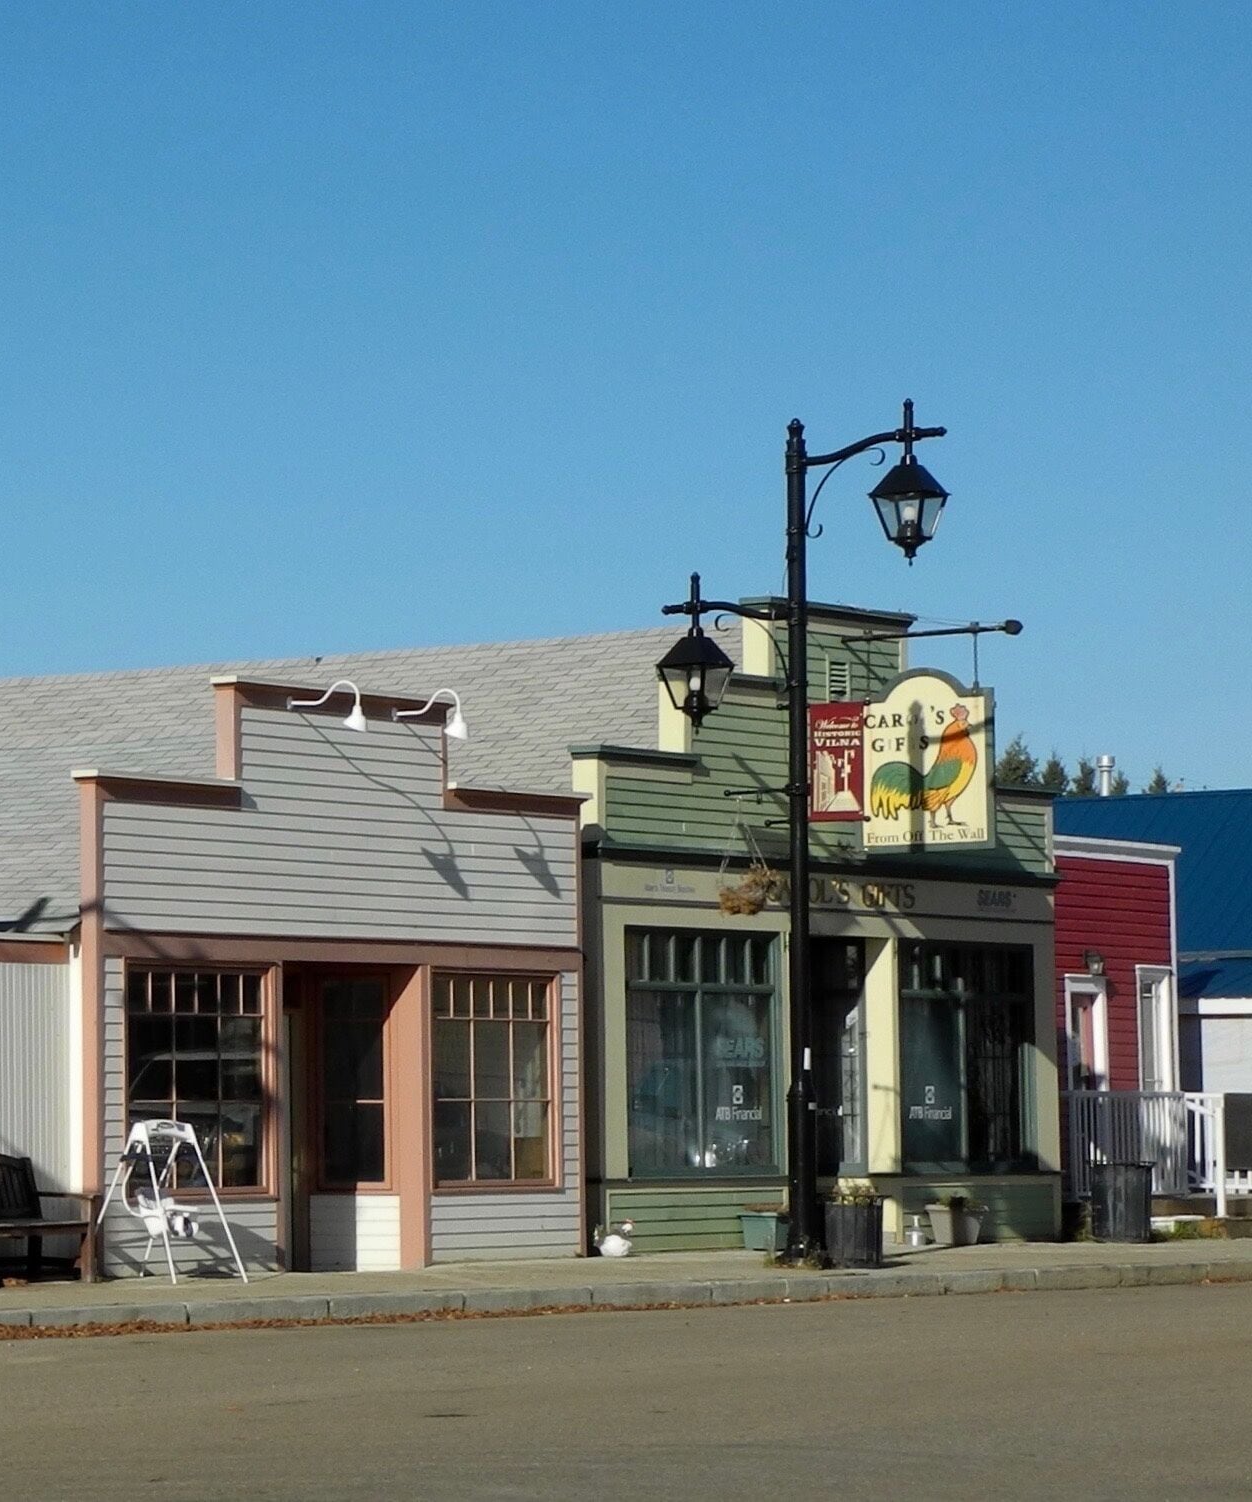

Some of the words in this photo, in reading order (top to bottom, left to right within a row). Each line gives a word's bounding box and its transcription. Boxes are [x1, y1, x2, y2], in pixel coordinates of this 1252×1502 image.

[814, 738, 860, 747] VILNA
[867, 832, 899, 844] From
[902, 830, 923, 843] Off
[929, 828, 954, 842] The
[957, 827, 985, 840] Wall
[861, 883, 917, 909] GIFTS
[977, 888, 1012, 908] SEARS
[715, 1106, 731, 1120] ATB
